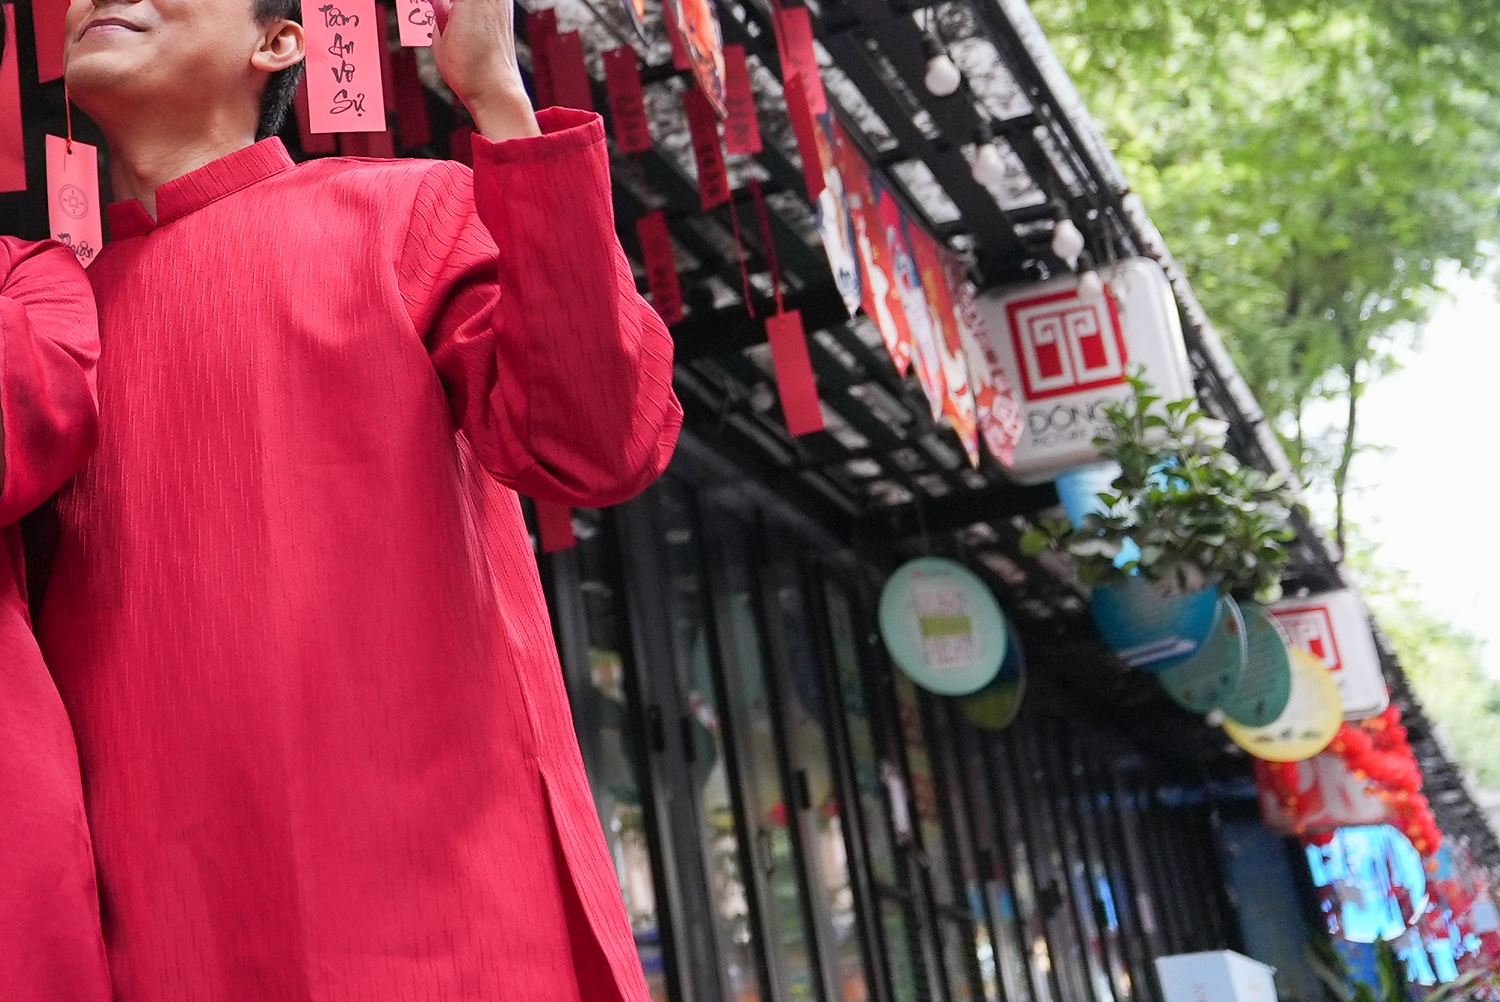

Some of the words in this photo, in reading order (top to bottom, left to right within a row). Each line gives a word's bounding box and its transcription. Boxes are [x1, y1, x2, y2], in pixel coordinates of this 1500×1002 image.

[318, 4, 359, 28] Tâm
[328, 33, 354, 58] An
[331, 60, 355, 83] Vô
[329, 89, 366, 117] Sự
